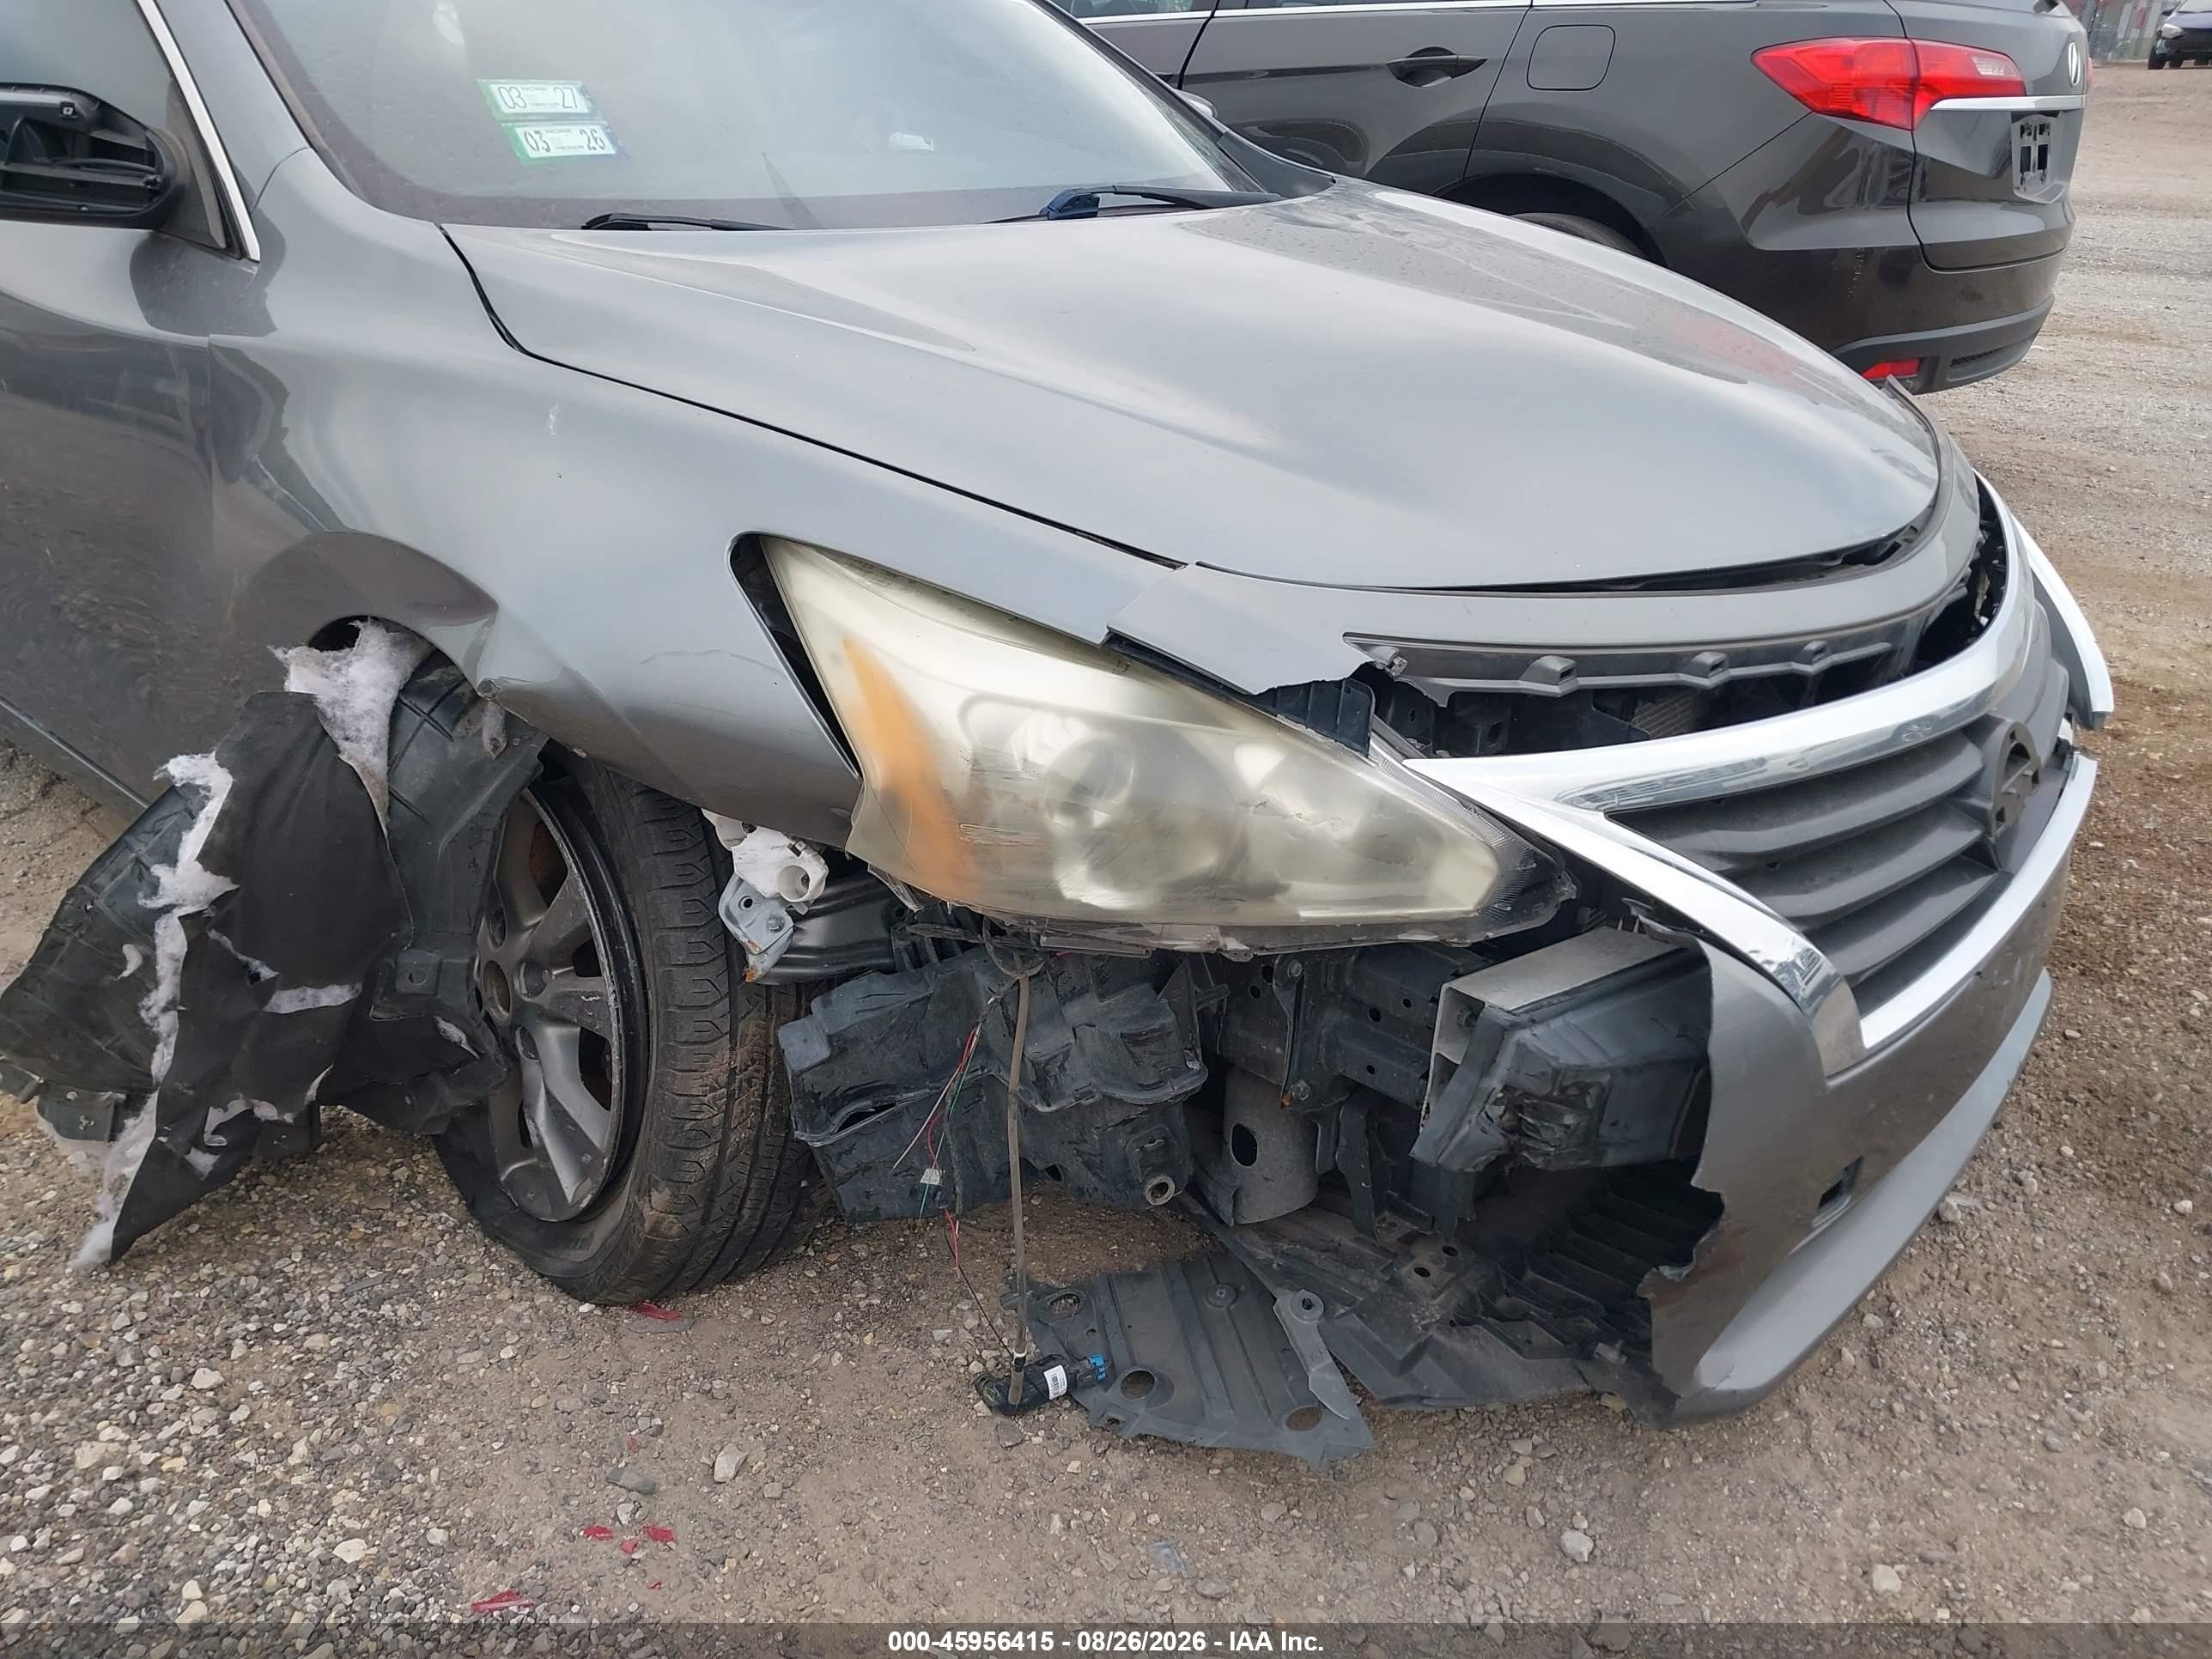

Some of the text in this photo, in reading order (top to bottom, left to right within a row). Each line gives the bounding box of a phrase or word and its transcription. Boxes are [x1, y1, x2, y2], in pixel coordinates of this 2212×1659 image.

[497, 86, 578, 109] 03 27
[523, 130, 551, 153] 03
